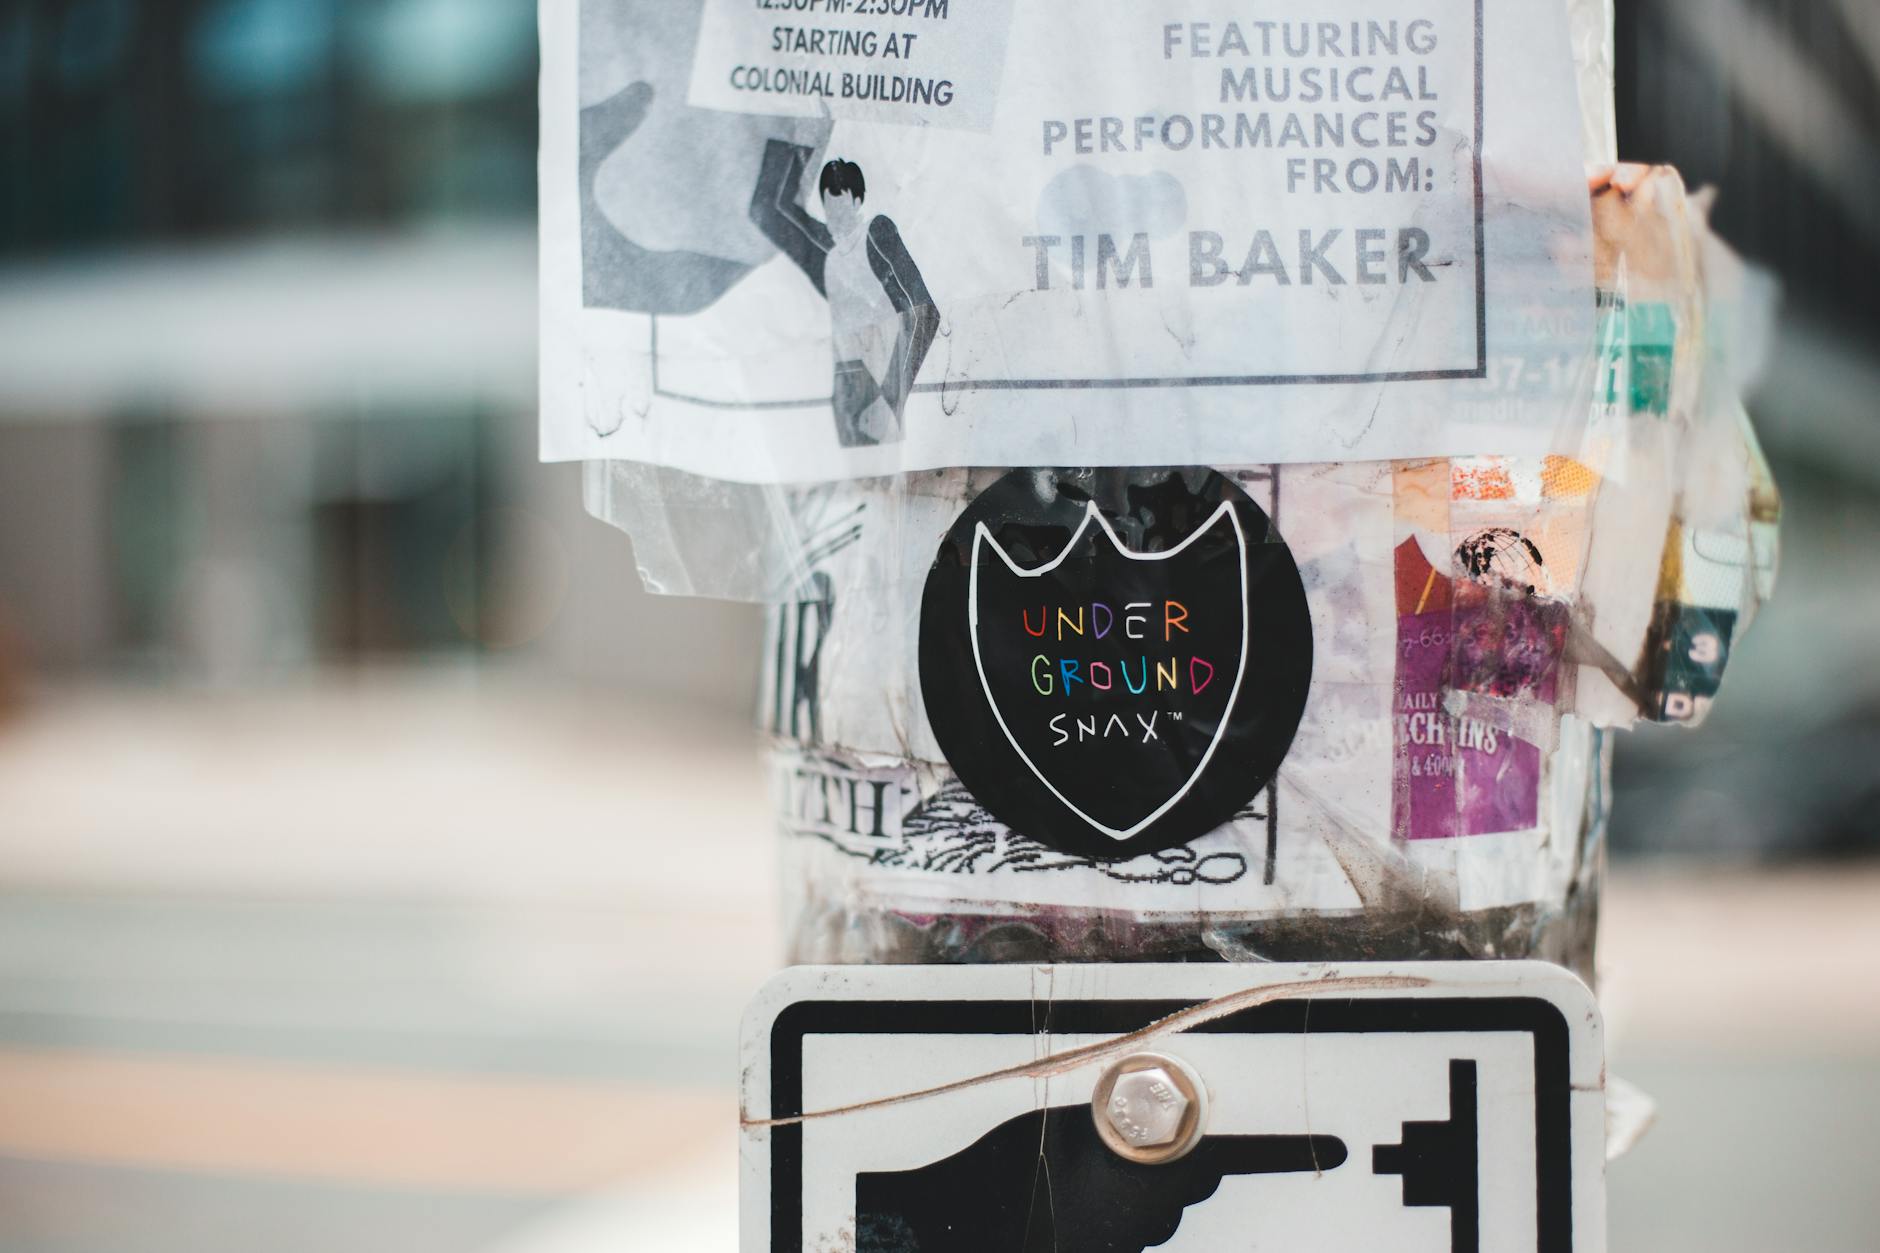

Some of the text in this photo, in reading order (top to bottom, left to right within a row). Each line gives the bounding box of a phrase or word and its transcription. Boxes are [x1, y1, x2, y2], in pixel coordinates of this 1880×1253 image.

[772, 26, 918, 59] STARTING AT
[1163, 19, 1438, 59] FEATURING
[730, 65, 954, 106] COLONIAL BUILDING
[1219, 65, 1438, 103] MUSICAL
[1042, 110, 1438, 155] PERFORMANCES
[1286, 157, 1434, 194] FROM:
[1022, 227, 1438, 291] TIM BAKER
[1023, 600, 1190, 641] UNDER
[1031, 654, 1214, 696] GROUND
[1399, 691, 1438, 709] AILY
